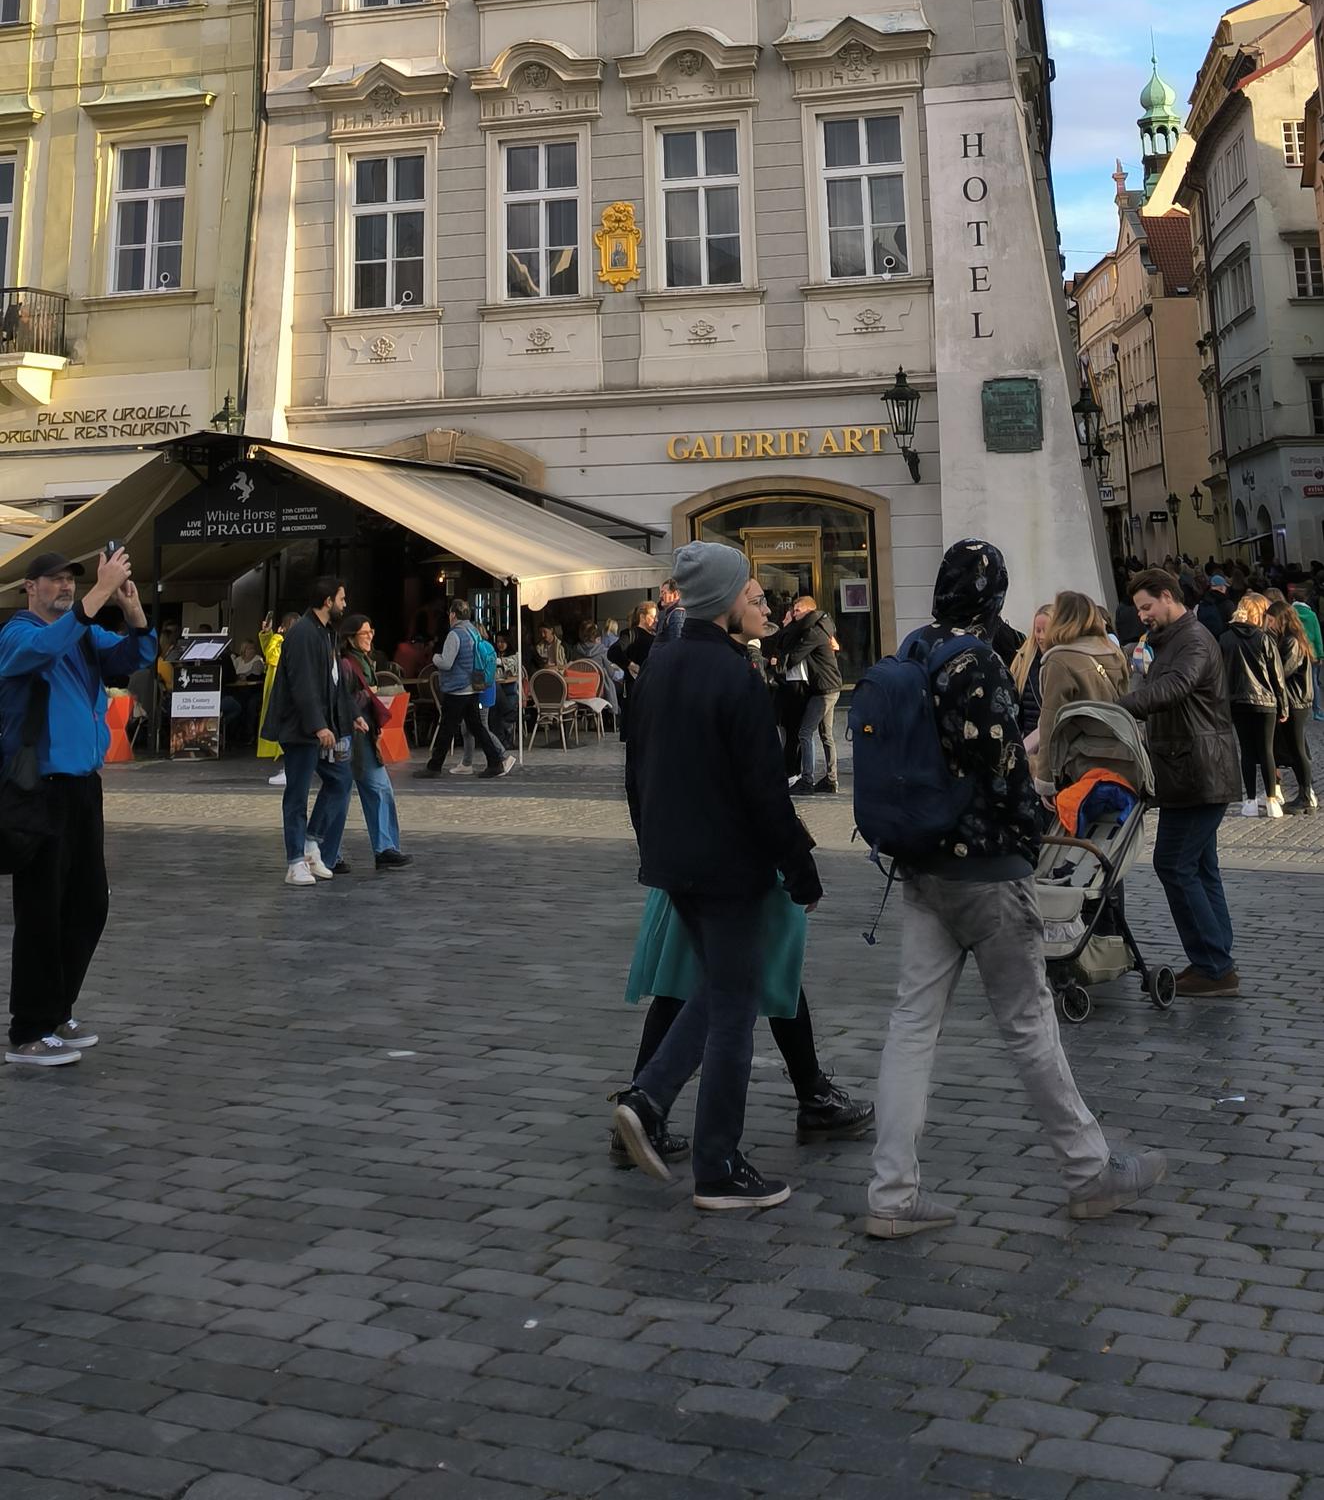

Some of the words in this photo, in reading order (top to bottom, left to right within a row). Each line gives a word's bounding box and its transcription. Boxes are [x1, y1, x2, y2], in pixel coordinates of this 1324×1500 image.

[960, 132, 994, 339] HOTEL
[37, 408, 107, 426] PILSNER
[112, 404, 191, 421] URQUELL
[0, 427, 69, 444] ORIGINAL
[74, 420, 191, 440] RESTAURANT
[667, 430, 811, 461] GALERIE
[818, 426, 889, 455] ART
[206, 510, 240, 522] White
[243, 509, 276, 520] Horse
[187, 520, 202, 528] LIVE
[207, 521, 277, 536] PRAGUE
[180, 529, 202, 537] MUSIC
[775, 541, 796, 550] ART
